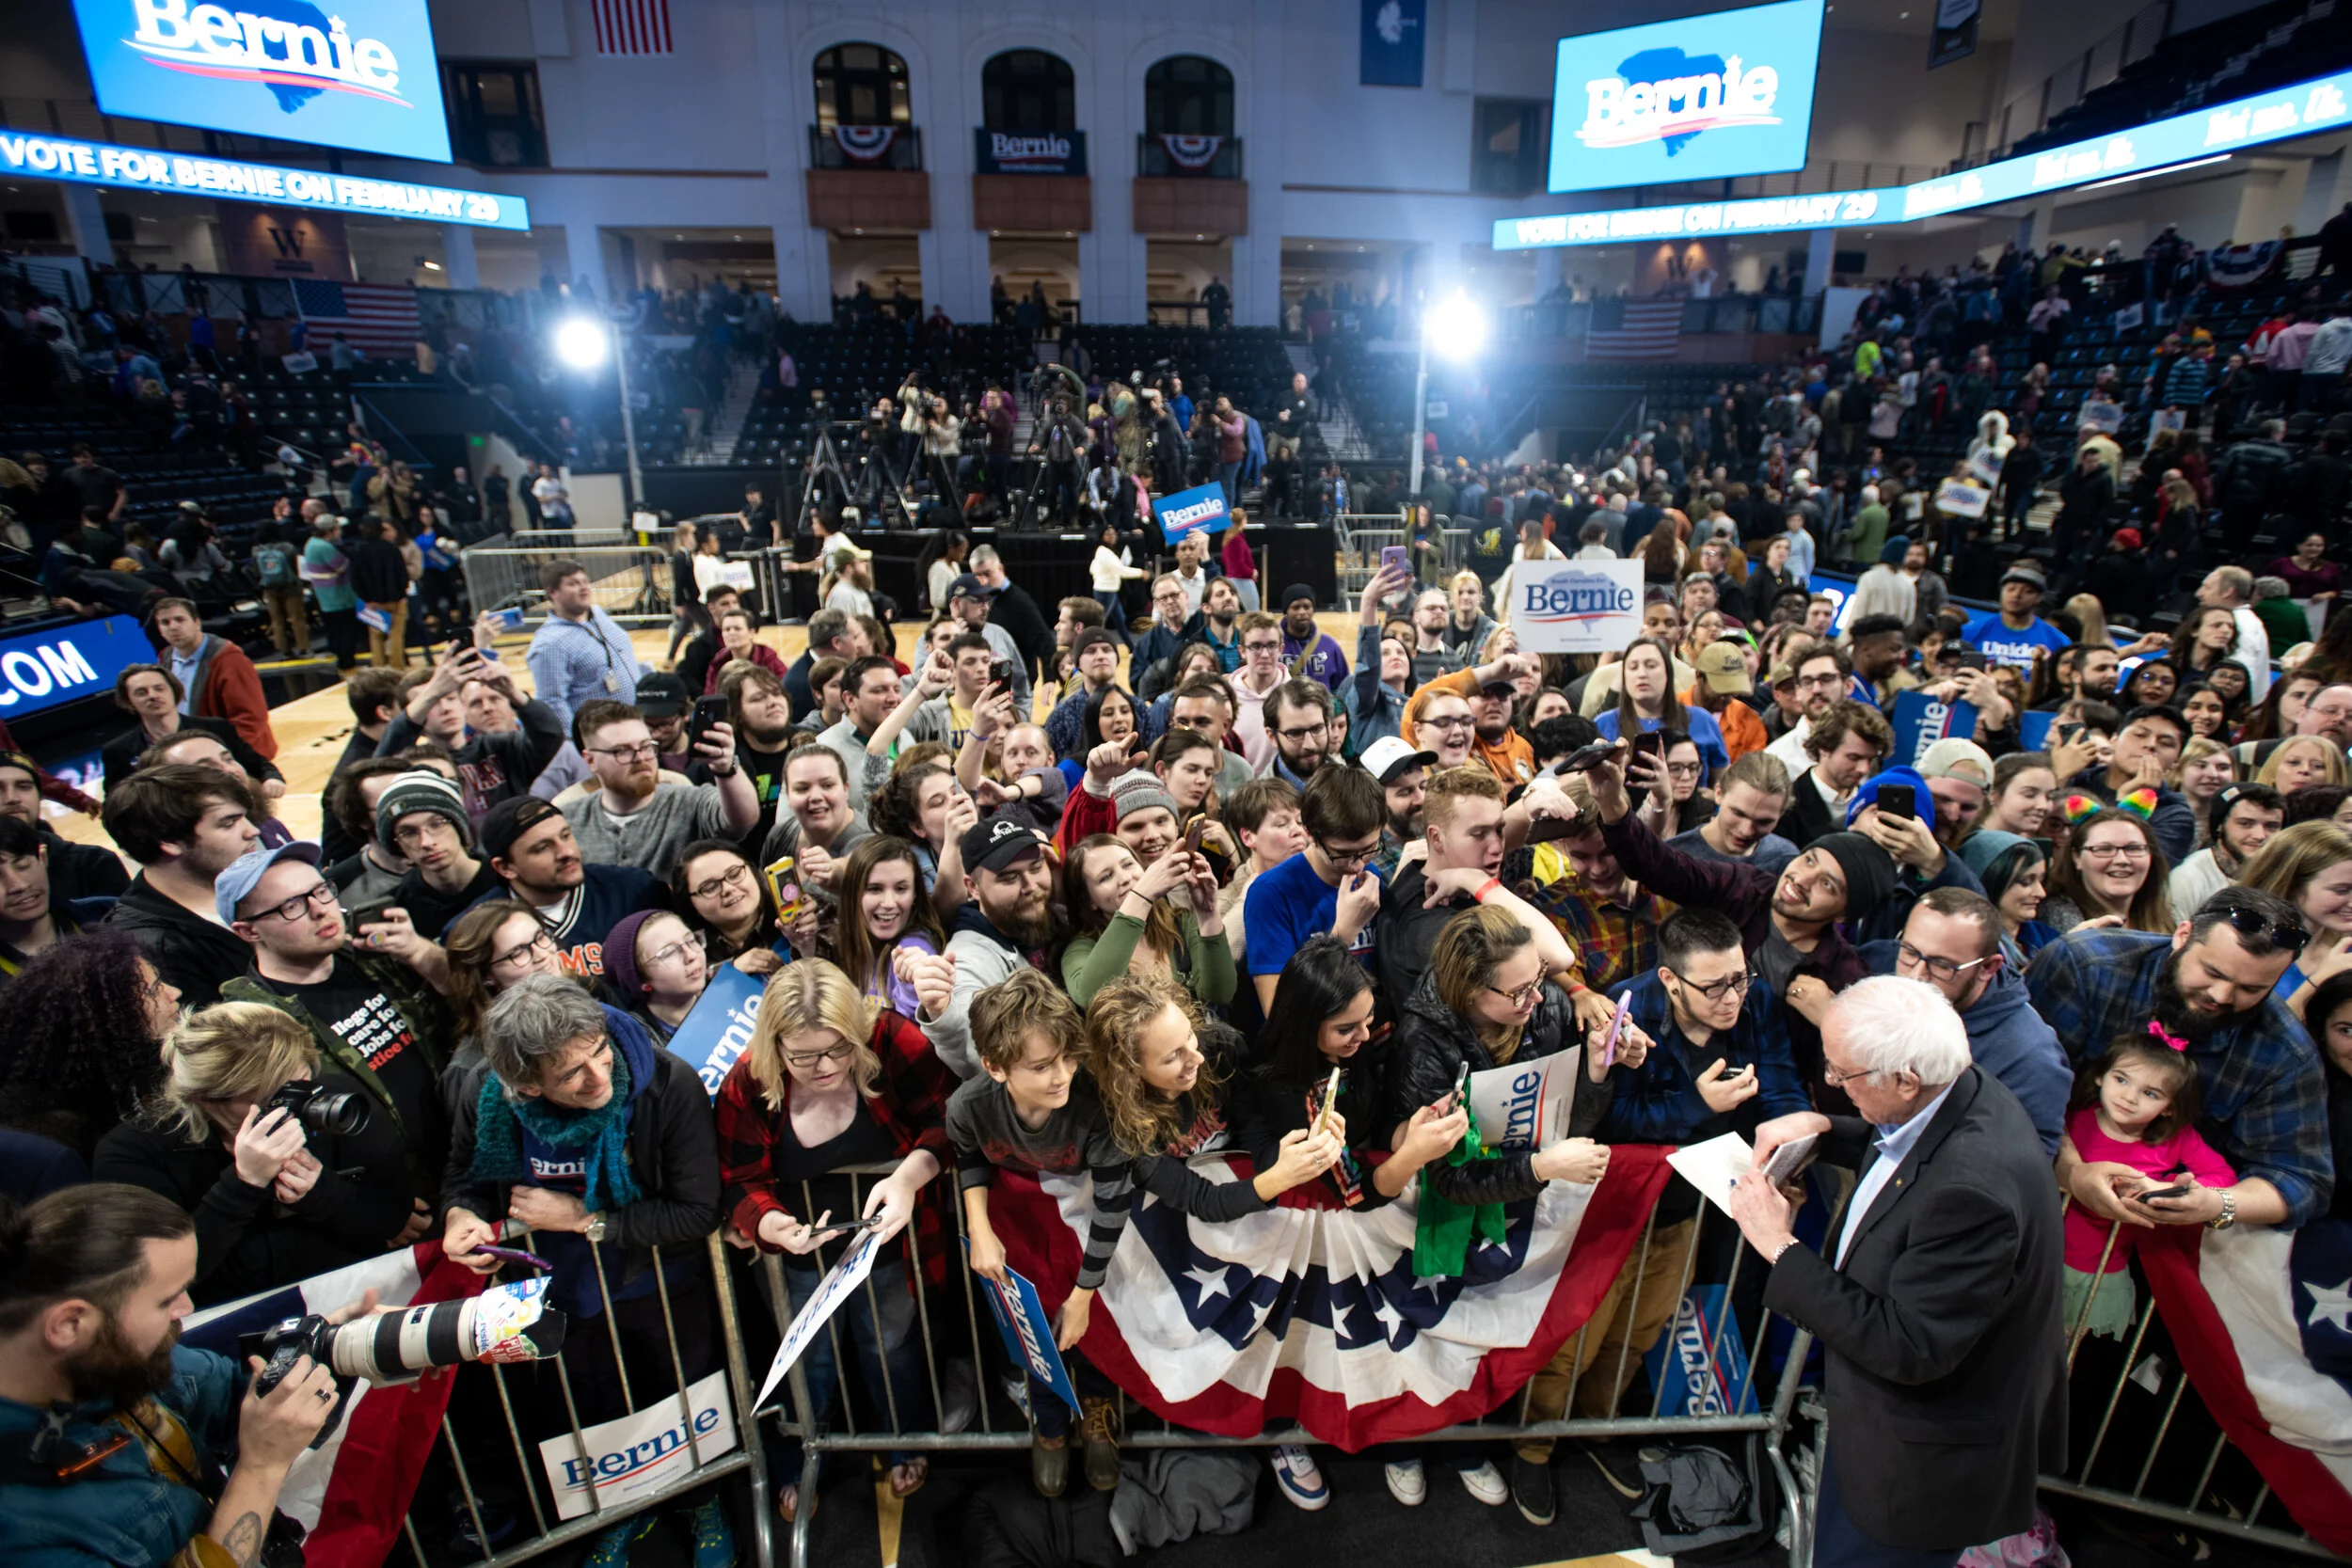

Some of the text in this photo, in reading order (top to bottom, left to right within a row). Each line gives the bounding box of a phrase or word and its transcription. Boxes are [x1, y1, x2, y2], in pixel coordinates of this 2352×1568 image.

[135, 0, 400, 91] Bernie
[1582, 55, 1779, 129] Bernie
[991, 133, 1071, 158] Bernie
[0, 136, 98, 175] VOTE
[100, 150, 172, 184] FOR
[173, 158, 283, 197] BERNIE
[285, 172, 334, 203] ON
[335, 178, 464, 217] FEBRUARY
[1684, 205, 1723, 232] ON
[267, 227, 306, 259] W
[1161, 498, 1224, 527] Bernie
[1524, 581, 1634, 613] Bernie
[347, 1019, 381, 1046] care
[358, 1030, 393, 1058] Jobs
[368, 1042, 403, 1071] stice
[561, 1407, 719, 1487] Bernie
